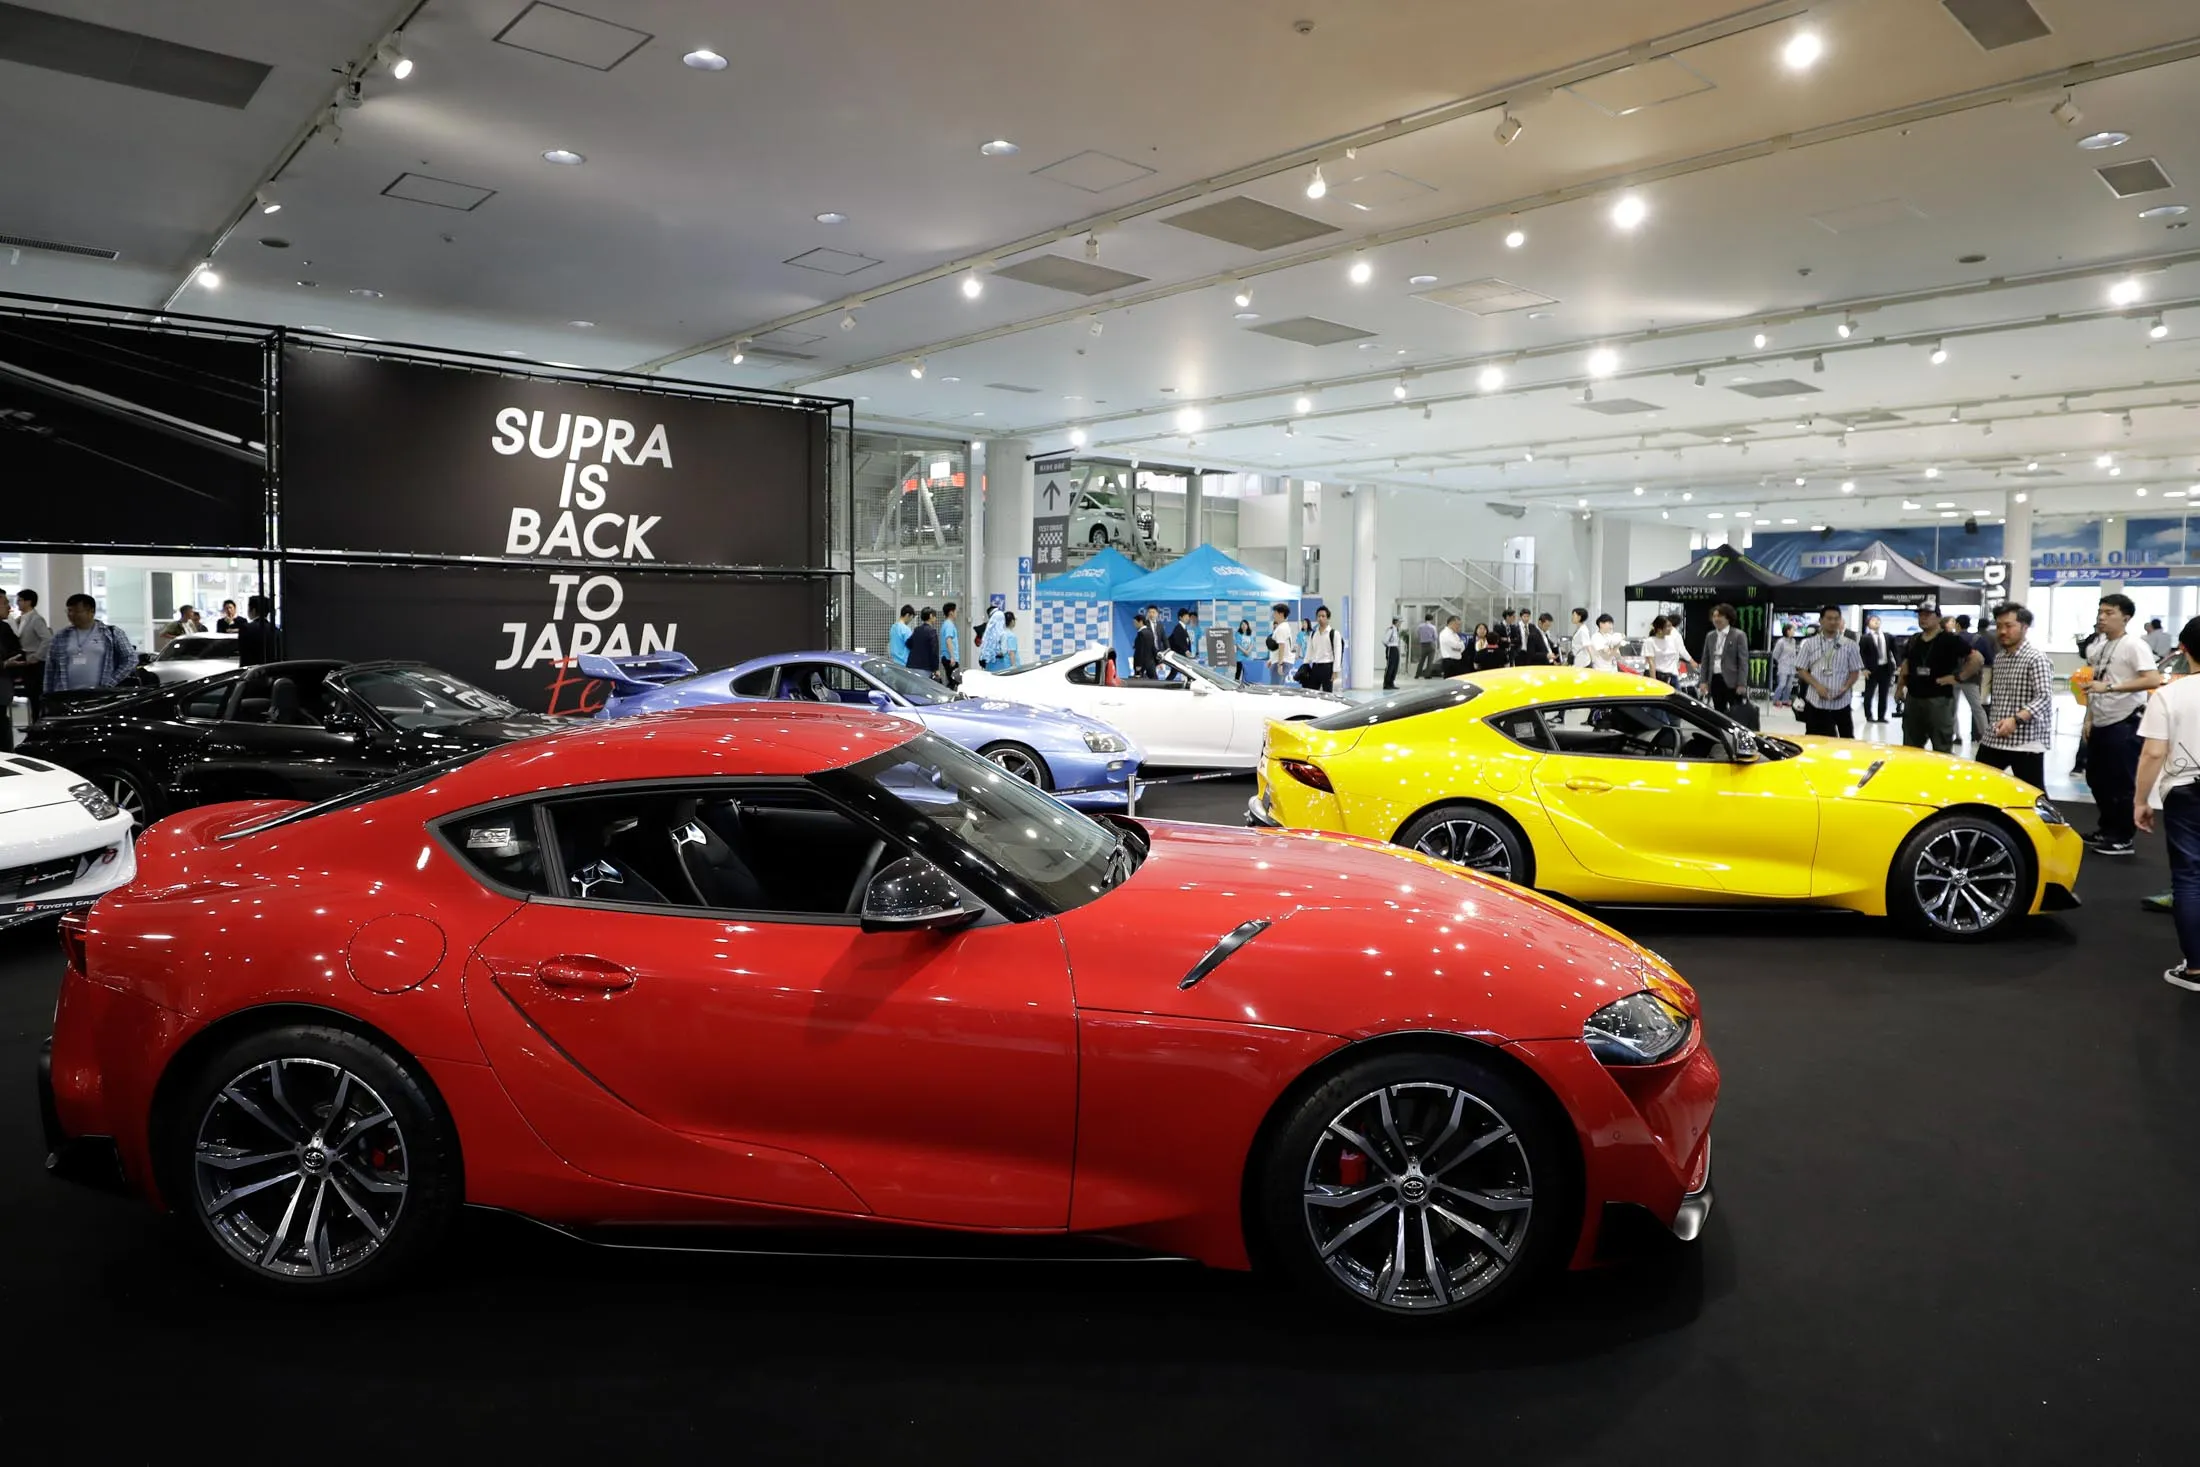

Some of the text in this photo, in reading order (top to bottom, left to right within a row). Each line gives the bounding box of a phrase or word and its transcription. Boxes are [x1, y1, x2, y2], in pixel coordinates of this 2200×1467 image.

[491, 407, 673, 468] SUPRA
[559, 462, 609, 510] IS
[505, 507, 662, 559] BACK
[1671, 586, 1717, 595] MONSTER
[1843, 559, 1887, 582] D1
[549, 574, 624, 621] TO
[495, 622, 677, 670] JAPAN
[37, 902, 73, 910] TOYOTA
